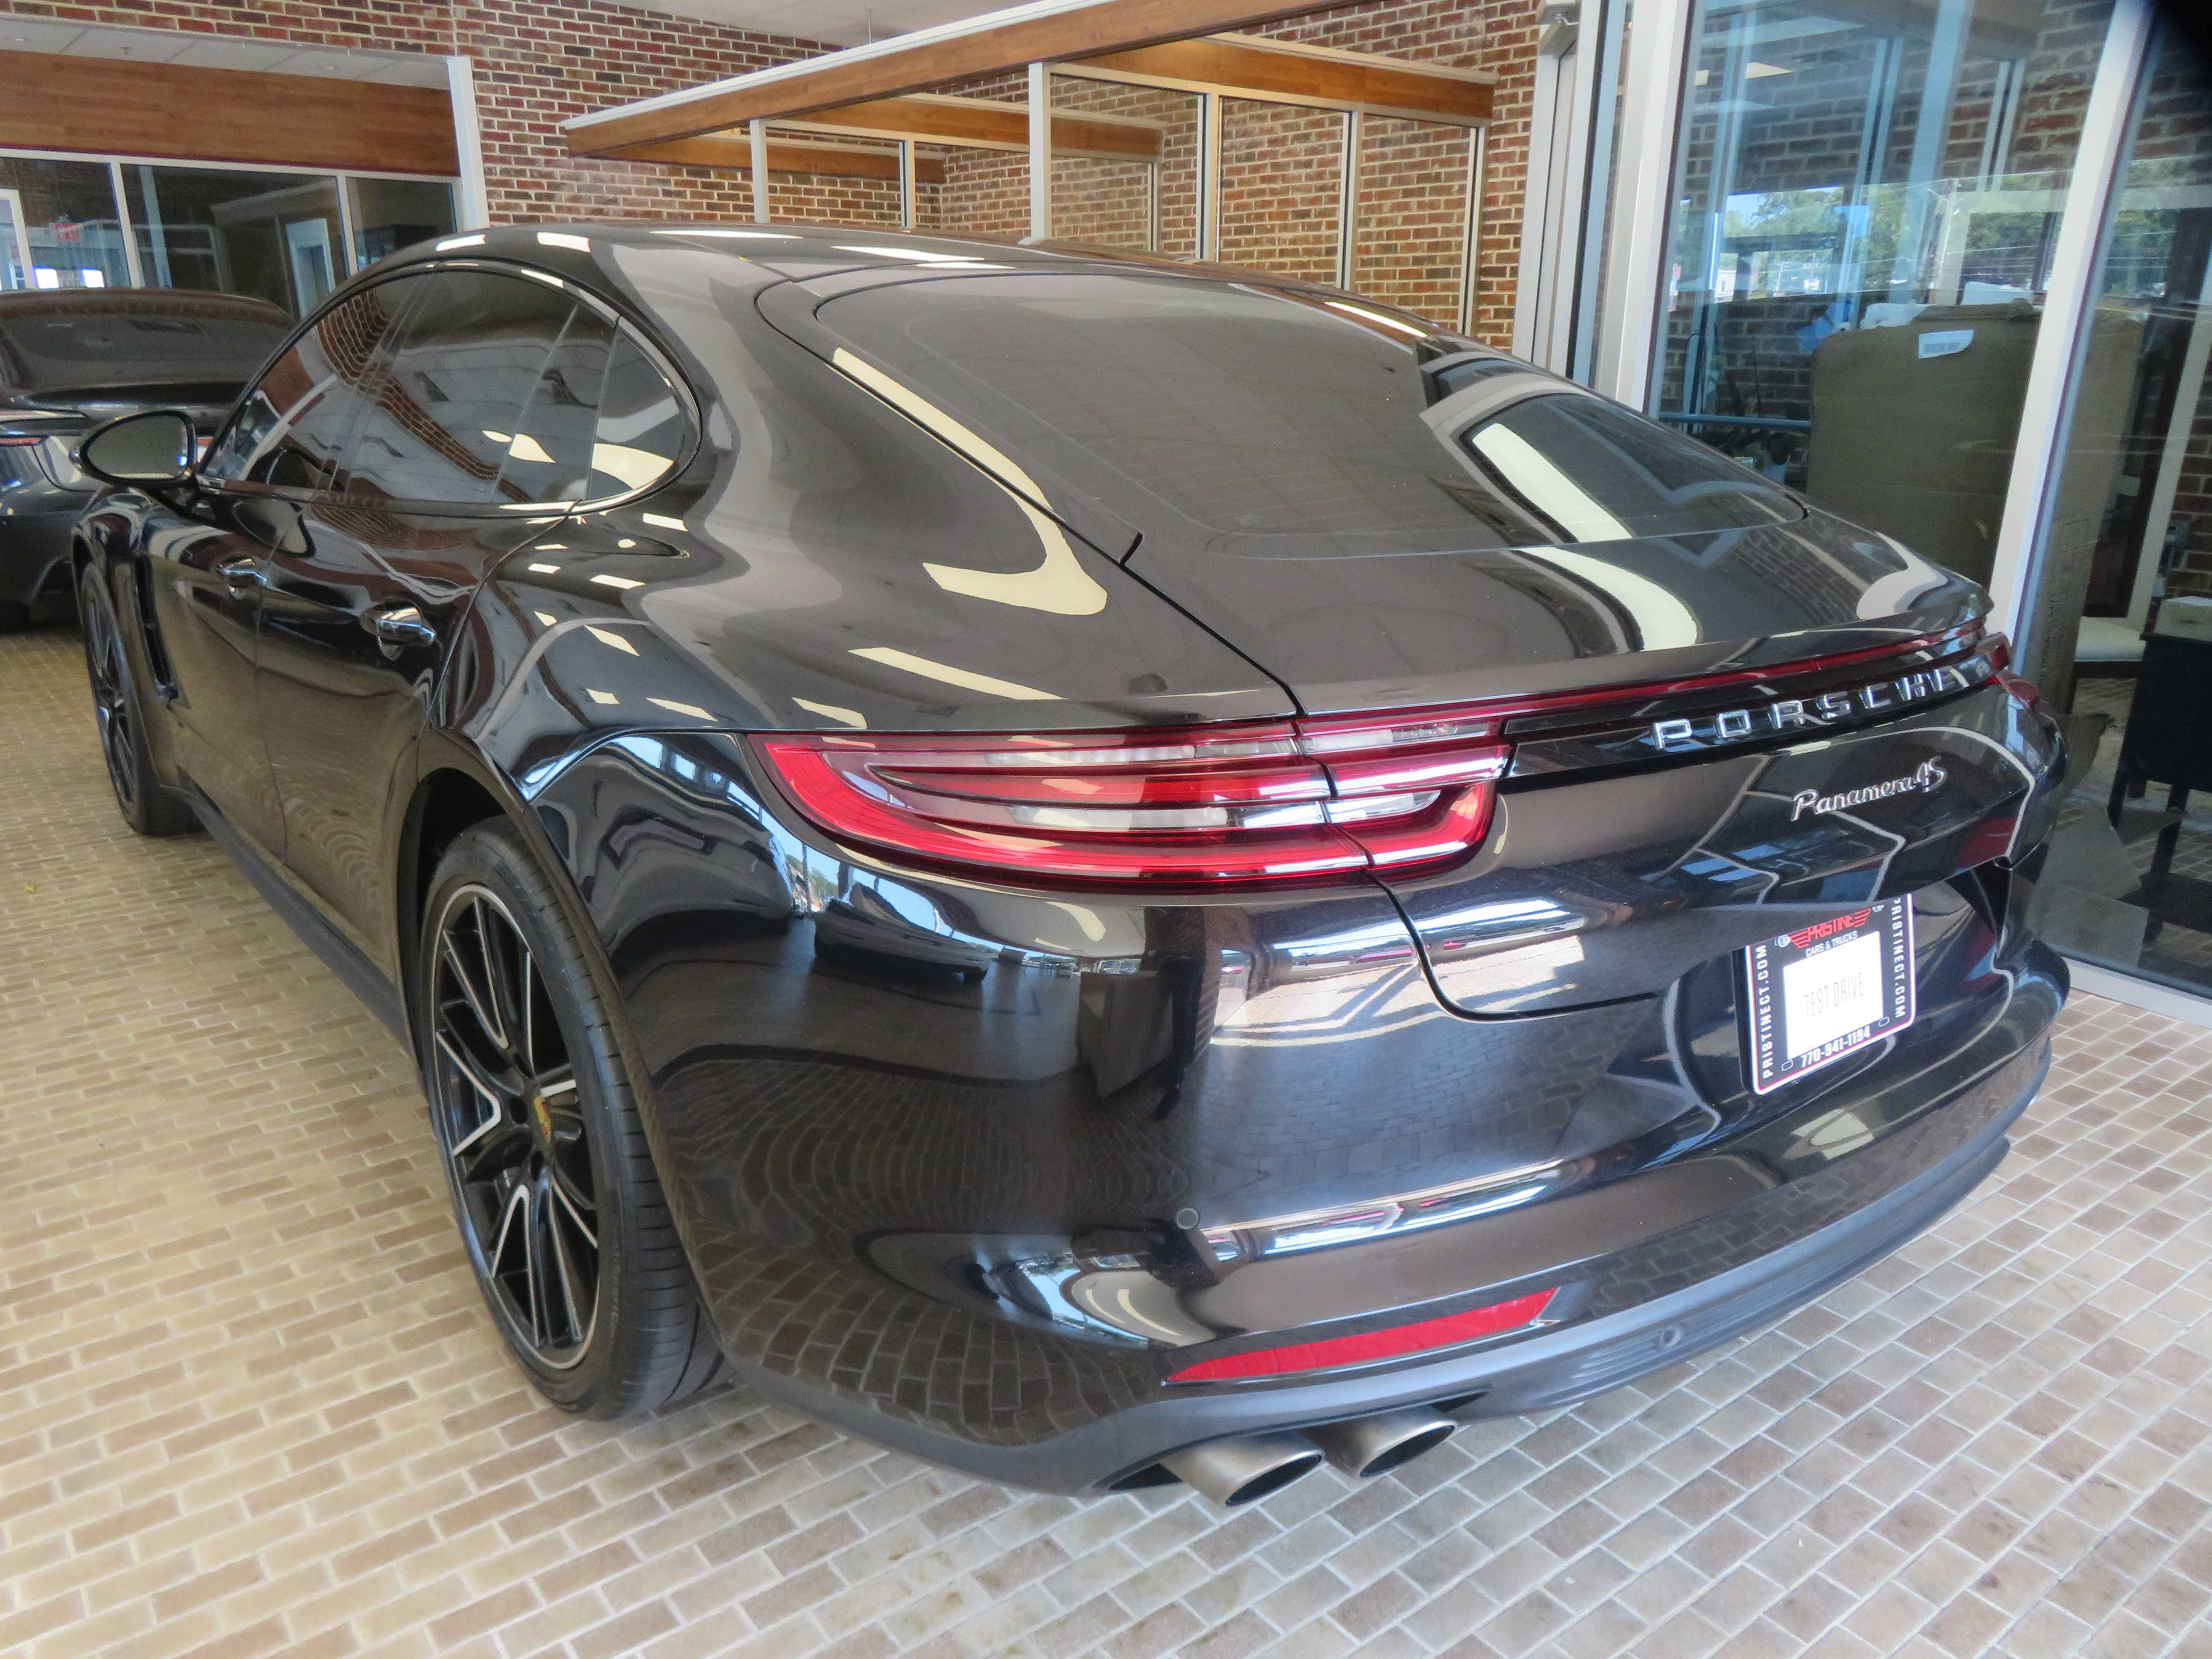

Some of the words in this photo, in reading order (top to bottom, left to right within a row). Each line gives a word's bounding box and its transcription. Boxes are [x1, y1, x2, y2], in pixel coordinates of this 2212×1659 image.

[1653, 666, 1956, 750] PORSCHE
[1805, 942, 1823, 957] CARS
[1824, 940, 1831, 950] &
[1831, 930, 1858, 946] TRUCKS
[1807, 914, 1855, 942] PRISTINE
[1755, 944, 1774, 1079] PRISTINECT.COM
[1803, 985, 1830, 1019] TEST
[1833, 971, 1864, 1007] DRIVE
[1801, 1025, 1871, 1068] 770-941-1194
